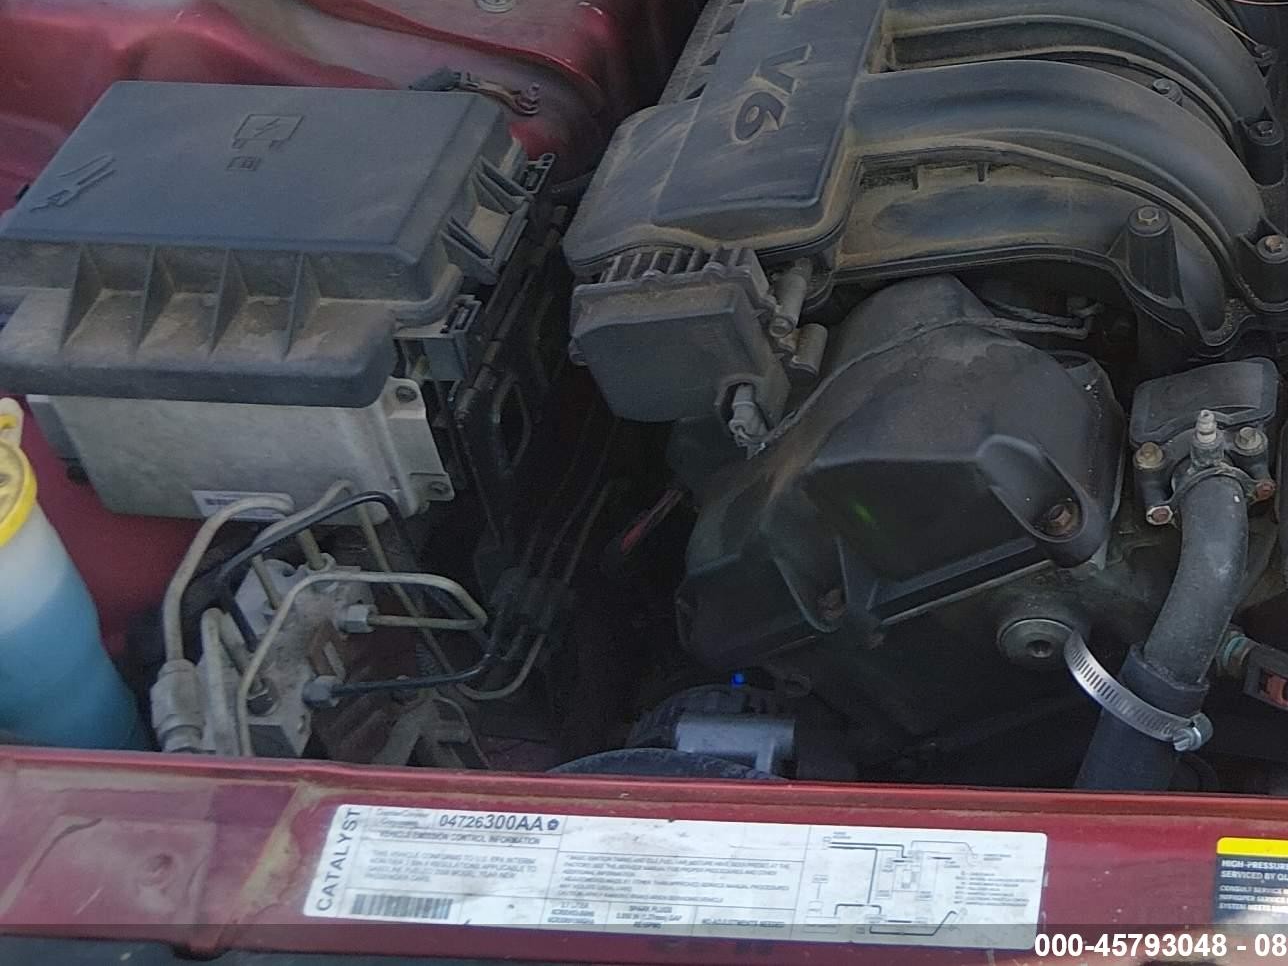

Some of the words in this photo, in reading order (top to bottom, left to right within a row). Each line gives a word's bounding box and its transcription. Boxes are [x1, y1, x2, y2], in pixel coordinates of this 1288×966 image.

[731, 43, 812, 144] V6
[315, 808, 361, 912] CATALYST
[439, 814, 543, 831] 04726300AA
